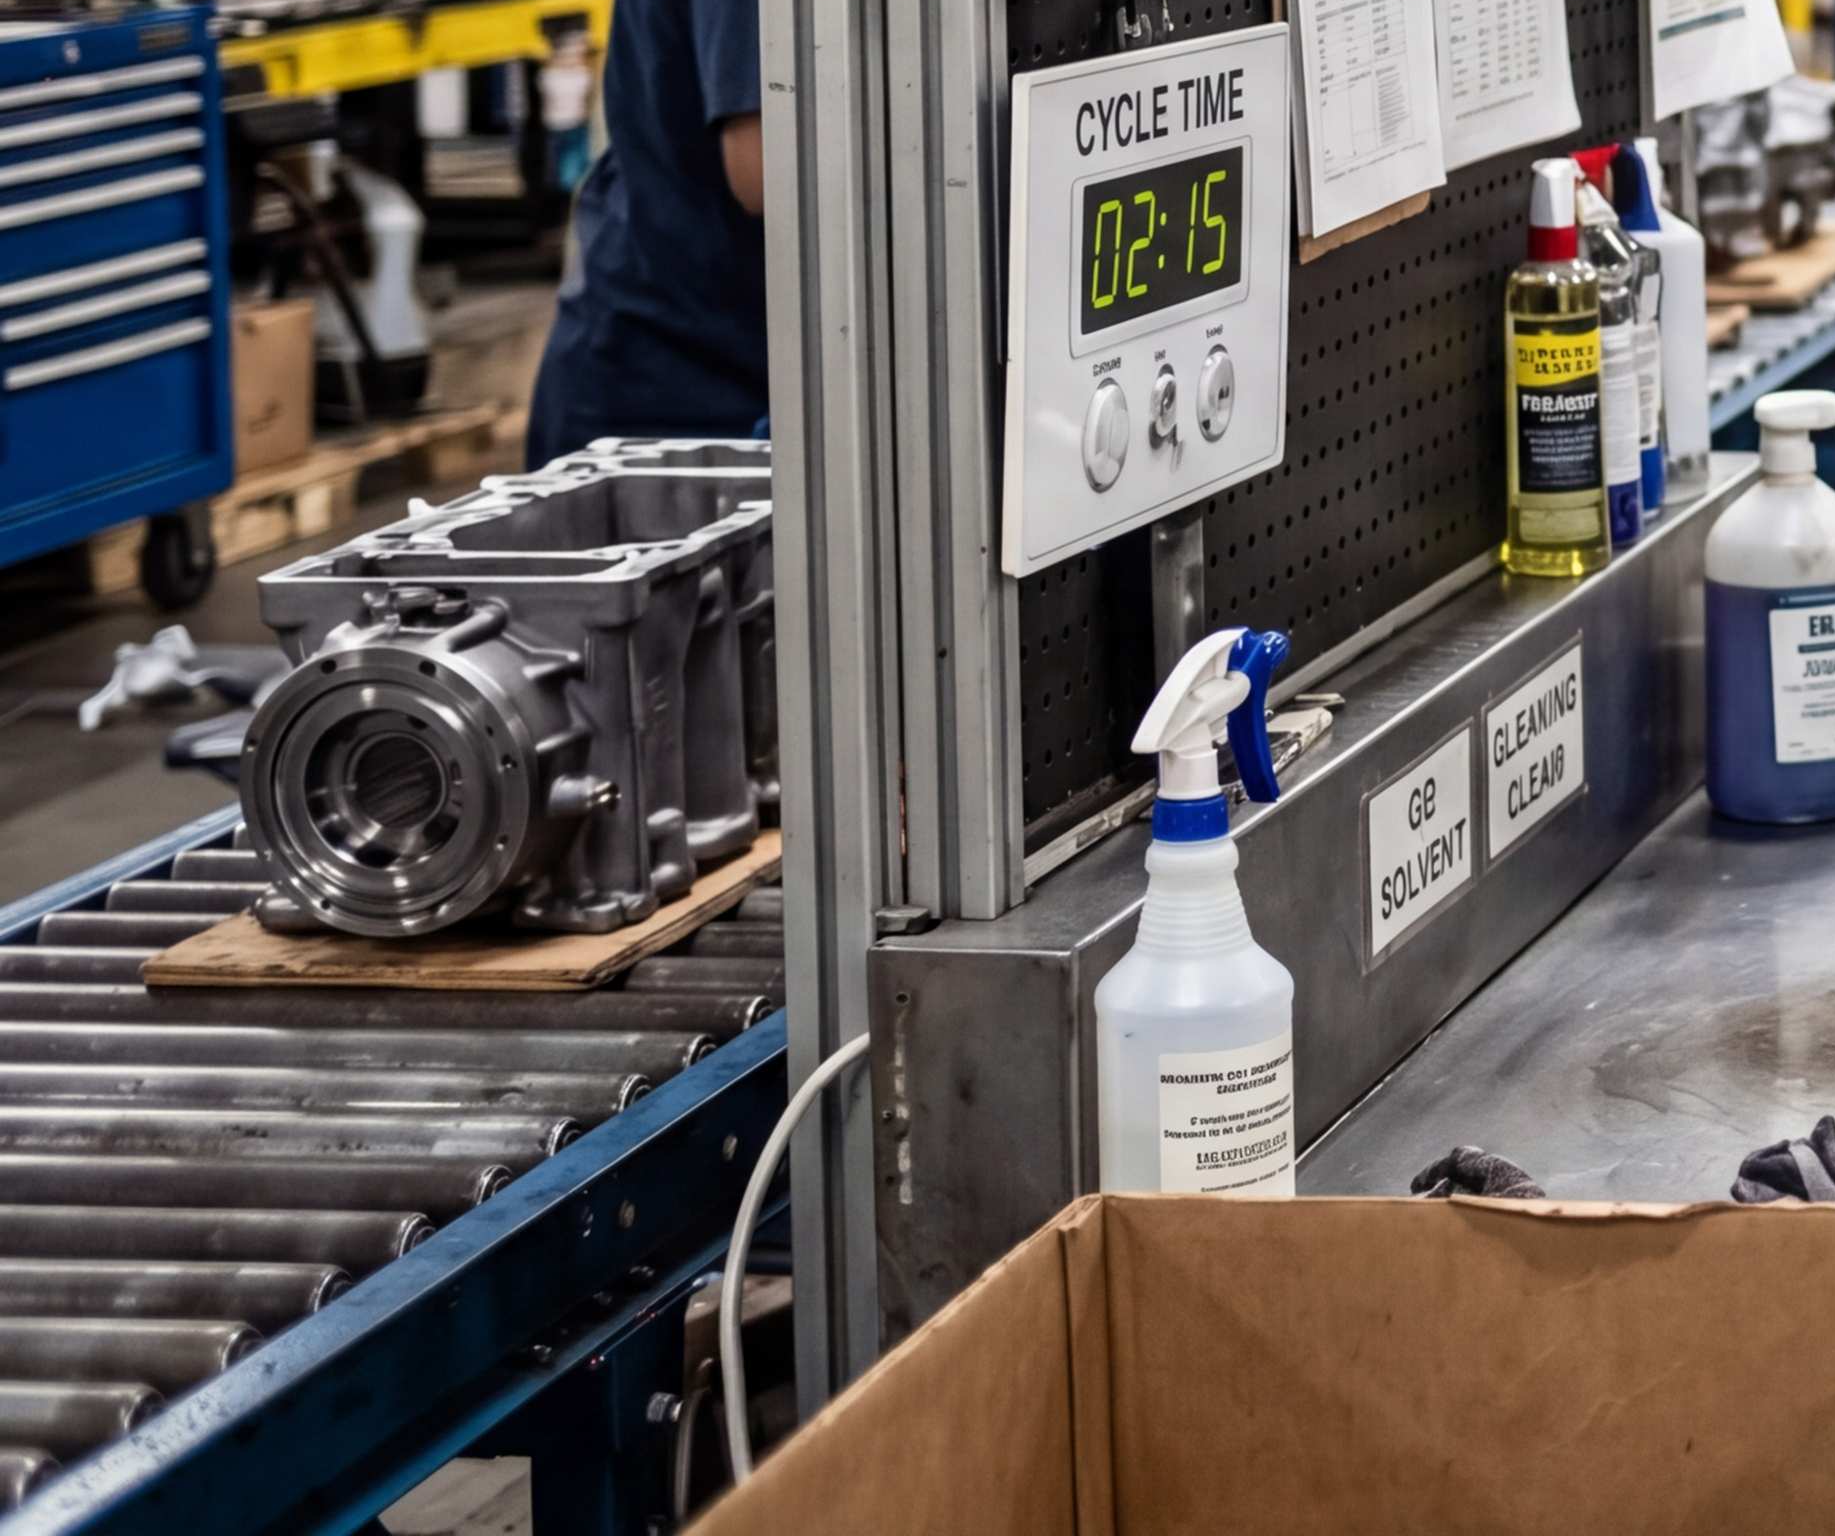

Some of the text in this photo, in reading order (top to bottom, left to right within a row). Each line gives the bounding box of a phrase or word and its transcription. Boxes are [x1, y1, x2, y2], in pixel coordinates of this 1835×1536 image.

[1075, 68, 1244, 157] CYCLE TIME
[1092, 169, 1227, 309] 02:15
[1381, 817, 1467, 921] SOLVENT
